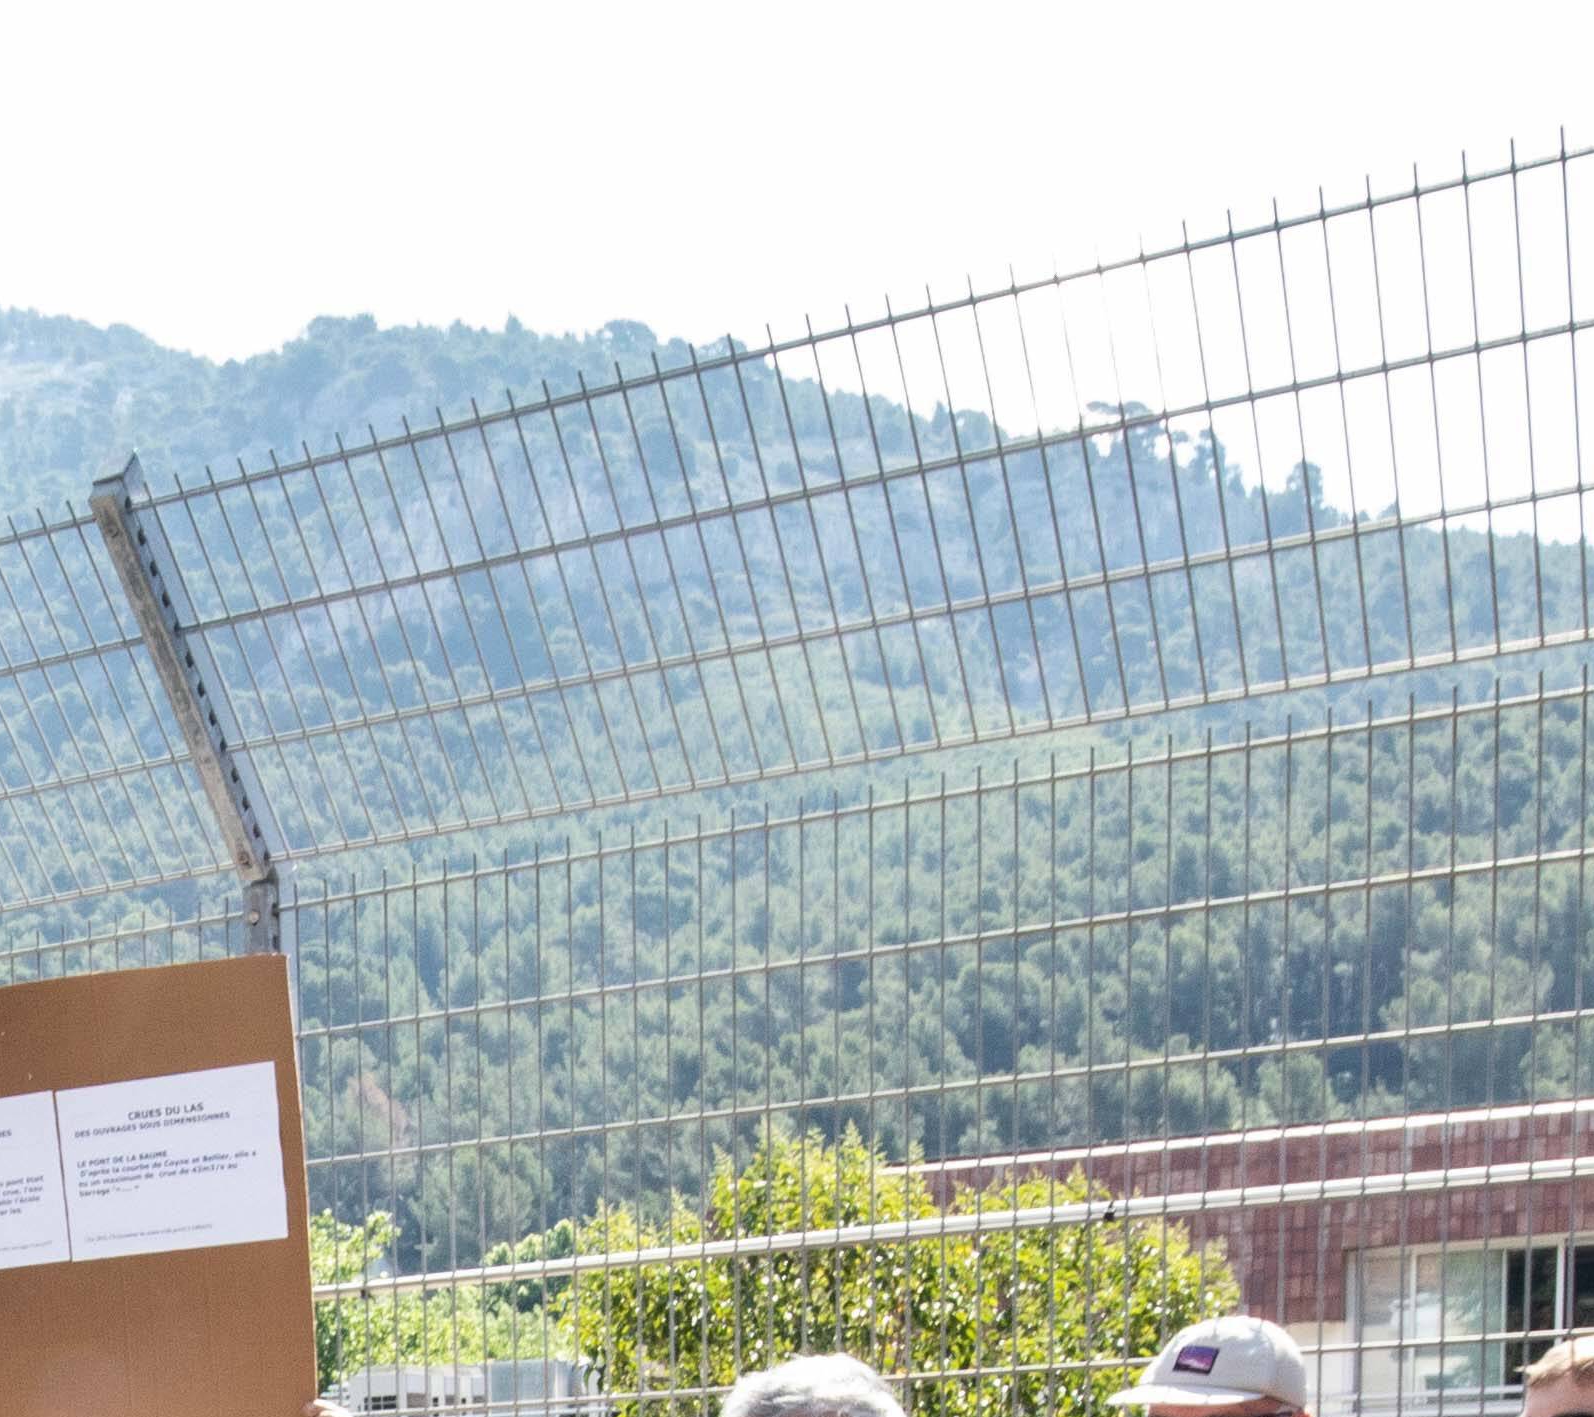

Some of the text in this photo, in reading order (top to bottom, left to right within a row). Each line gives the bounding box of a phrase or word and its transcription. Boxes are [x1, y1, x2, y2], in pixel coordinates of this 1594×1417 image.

[128, 1102, 204, 1120] CRUES DU LAS
[75, 1129, 91, 1138] DES
[93, 1124, 136, 1136] OUVRAGES
[139, 1120, 161, 1130] SOUS
[89, 1157, 110, 1166] PONT
